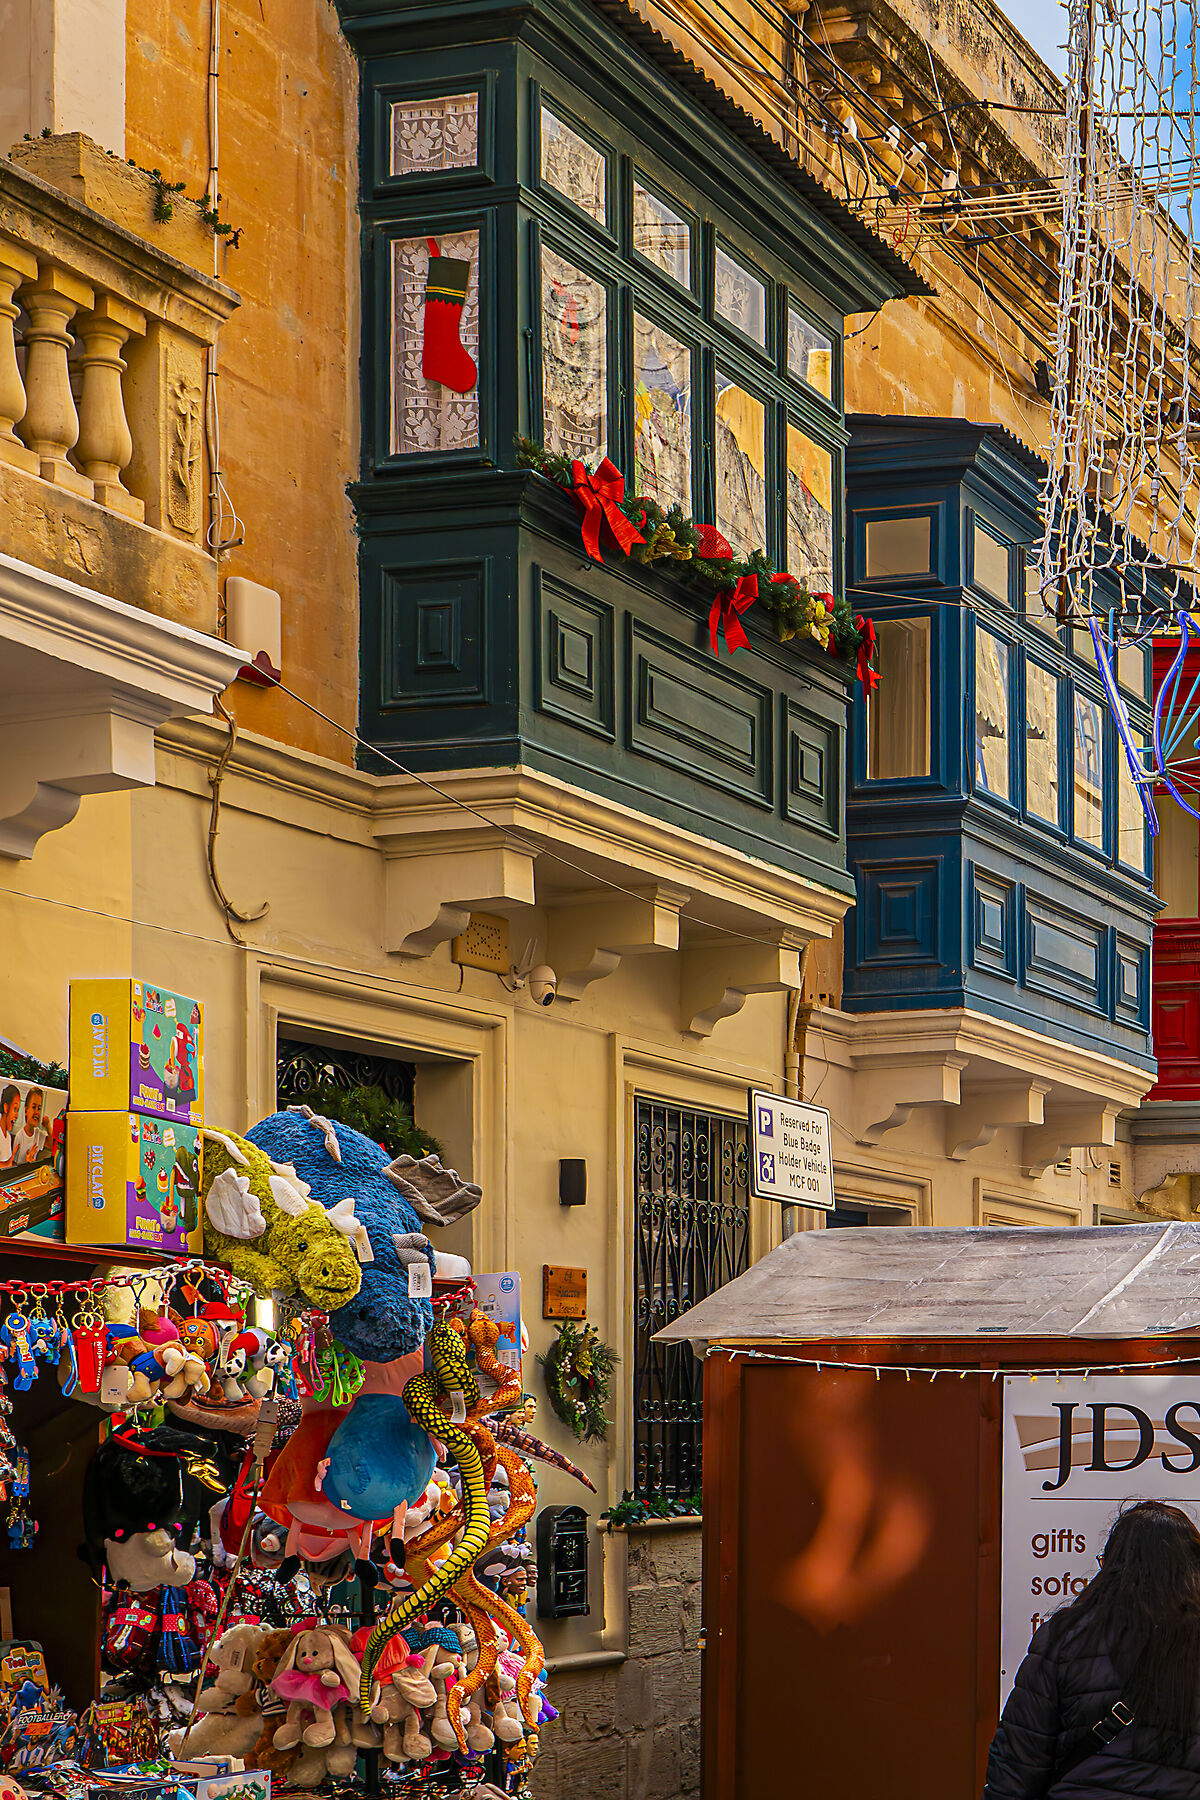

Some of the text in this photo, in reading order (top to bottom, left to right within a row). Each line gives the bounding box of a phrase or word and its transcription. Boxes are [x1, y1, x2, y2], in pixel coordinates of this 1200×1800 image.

[93, 1026, 104, 1057] CLAY
[93, 1058, 104, 1078] DIY
[780, 1112, 823, 1136] Reserved For
[92, 1145, 103, 1165] DIY
[783, 1132, 821, 1156] Blue Badge
[778, 1151, 827, 1175] Holder Vehicle
[92, 1166, 103, 1197] CLAY
[789, 1173, 820, 1193] MCF 001
[1031, 1529, 1086, 1559] gifts
